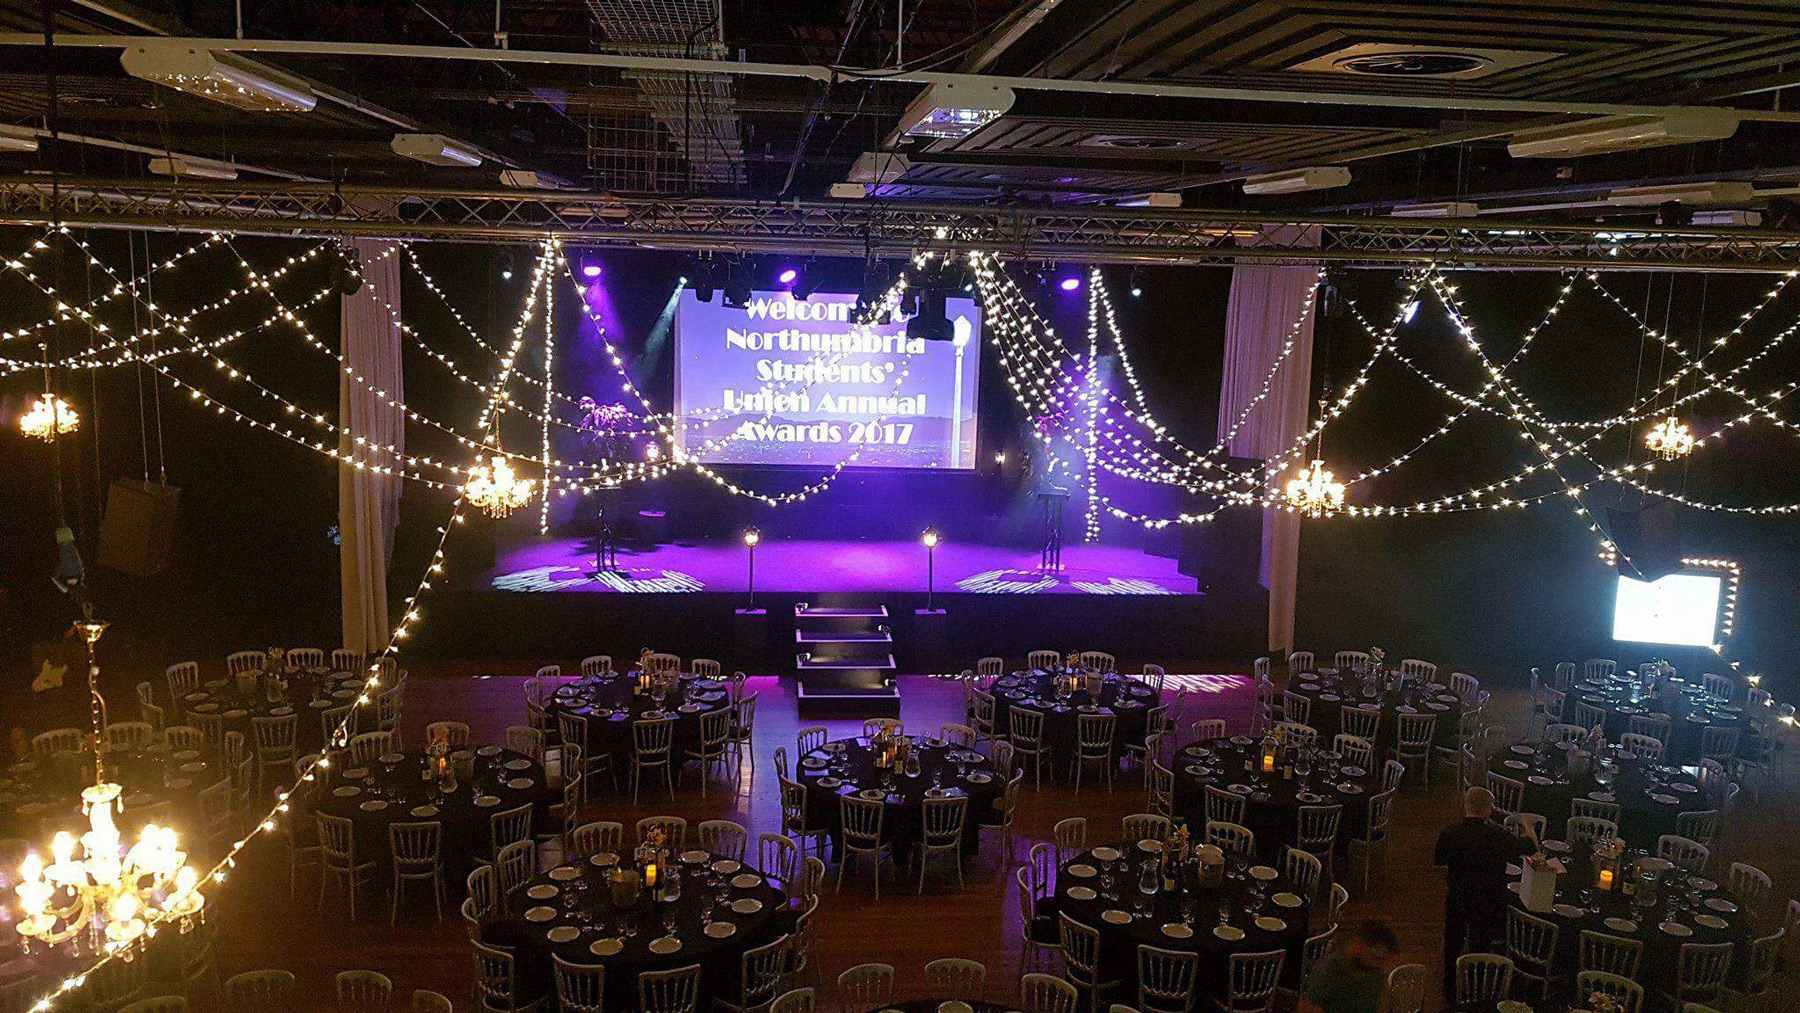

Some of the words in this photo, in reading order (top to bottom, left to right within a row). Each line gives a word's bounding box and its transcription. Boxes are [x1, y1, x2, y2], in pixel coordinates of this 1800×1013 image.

[746, 297, 858, 321] Welcom
[725, 327, 926, 355] Northumbria
[723, 389, 811, 413] Union
[815, 391, 927, 415] Annual
[737, 420, 842, 444] Awards
[848, 422, 914, 446] 2017
